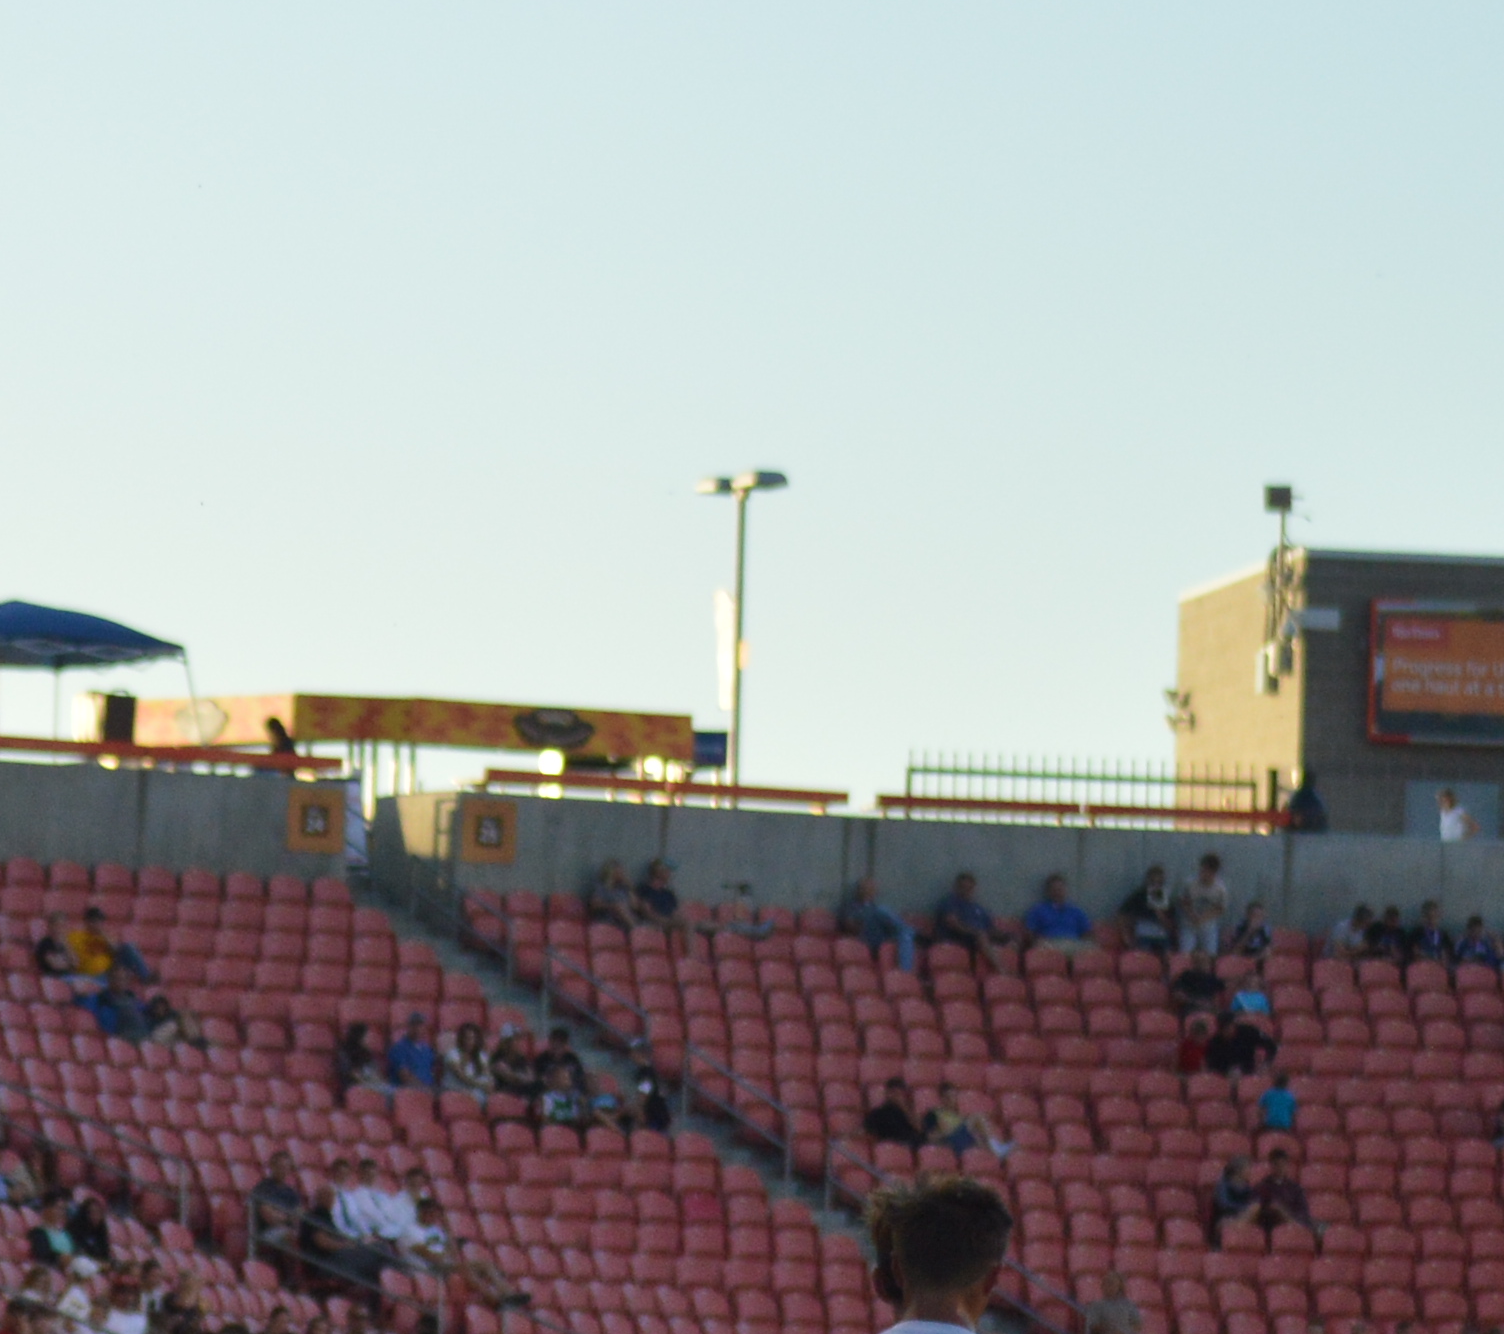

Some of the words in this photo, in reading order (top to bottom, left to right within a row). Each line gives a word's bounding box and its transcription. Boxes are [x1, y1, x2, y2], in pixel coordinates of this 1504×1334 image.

[1392, 657, 1462, 679] Progress
[1466, 659, 1488, 677] for
[1392, 679, 1421, 693] one
[1463, 680, 1480, 696] at
[1484, 683, 1495, 696] a
